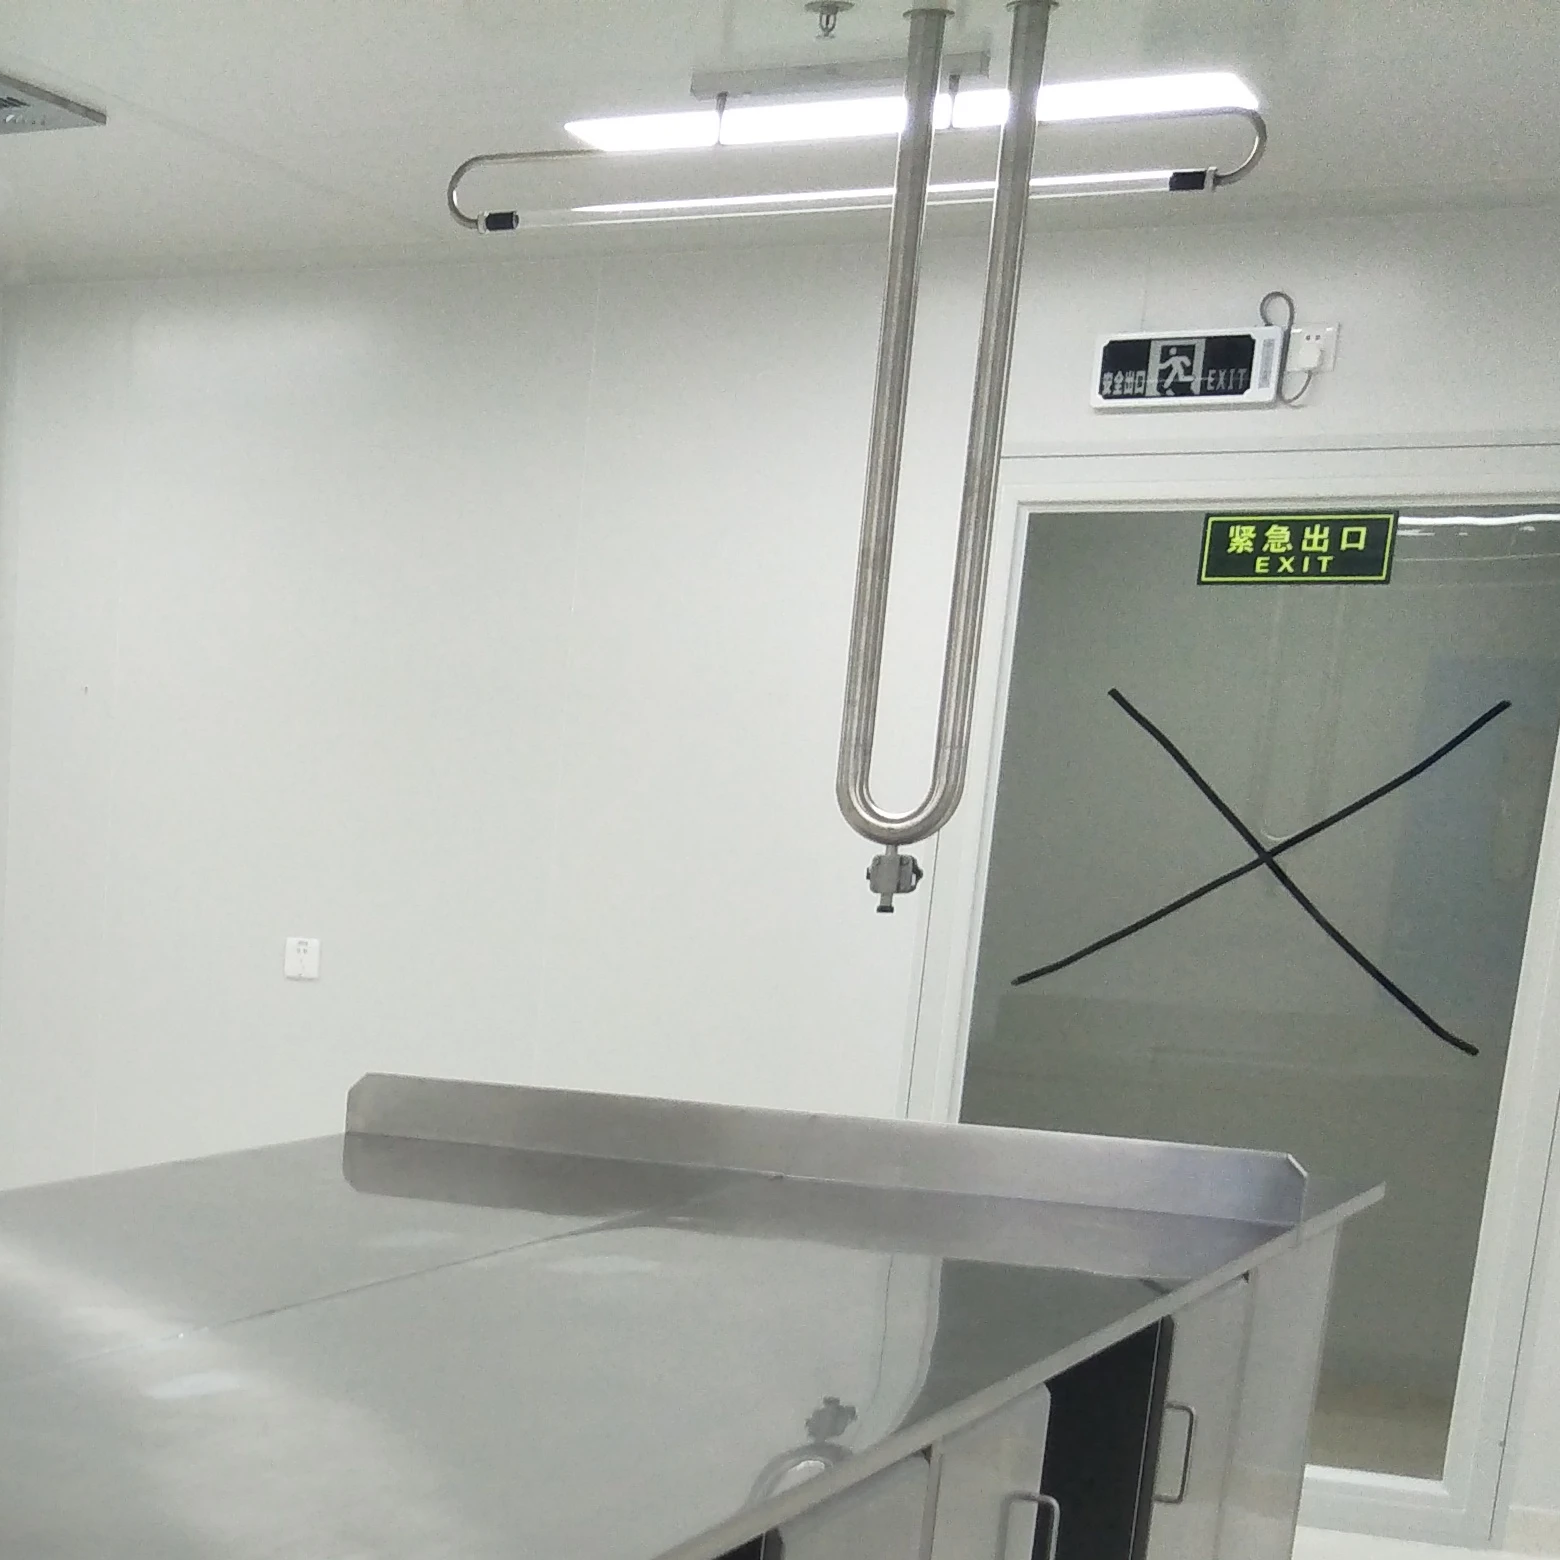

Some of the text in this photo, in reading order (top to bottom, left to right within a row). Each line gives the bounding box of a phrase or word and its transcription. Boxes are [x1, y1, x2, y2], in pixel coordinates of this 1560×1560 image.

[1102, 370, 1146, 395] 安全出口
[1206, 368, 1248, 391] EXIT
[1227, 523, 1367, 554] 紧急出口
[1254, 556, 1334, 573] EXIT
